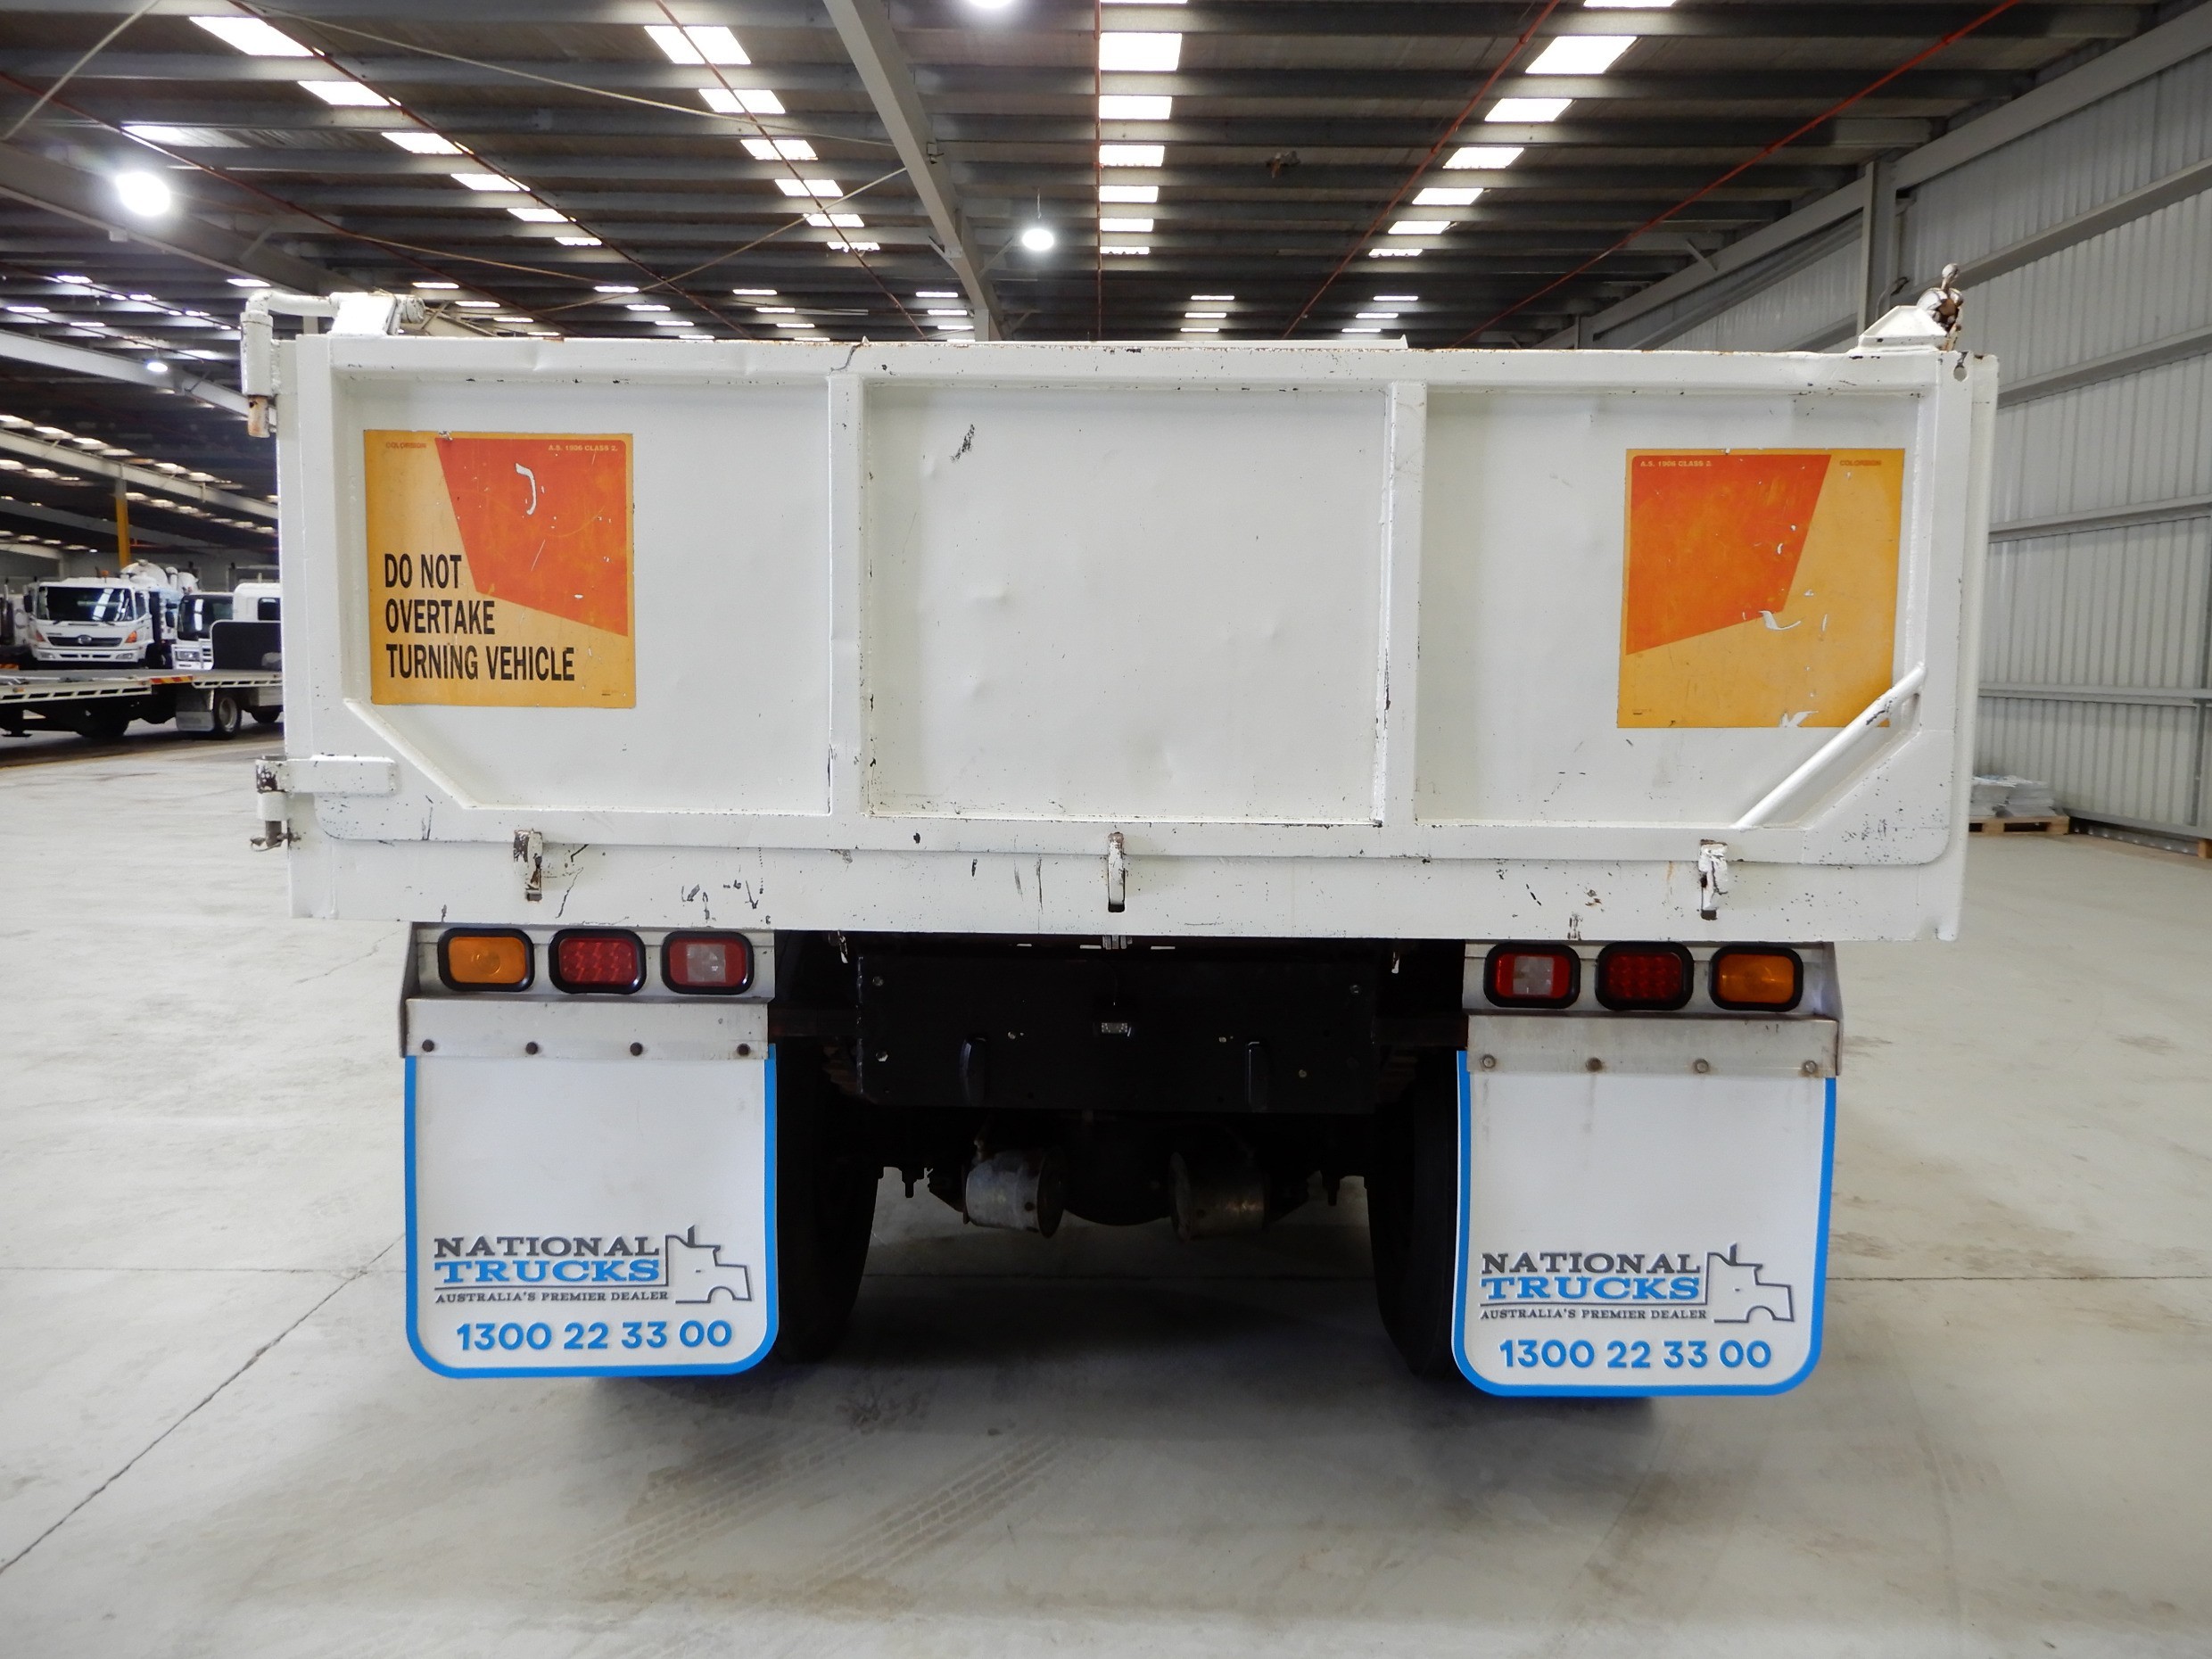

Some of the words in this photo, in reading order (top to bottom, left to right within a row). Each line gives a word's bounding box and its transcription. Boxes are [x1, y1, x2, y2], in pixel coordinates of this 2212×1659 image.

[384, 553, 413, 588] DO
[421, 554, 462, 589] NOT
[385, 599, 495, 635] OVERTAKE
[386, 644, 478, 680] TURNING
[486, 647, 574, 681] VEHICLE
[433, 1236, 660, 1258] NATIONAL
[433, 1259, 660, 1283] TRUCKS
[1482, 1252, 1701, 1274] NATIONAL
[435, 1292, 536, 1304] AUSTRALIA'S
[541, 1292, 606, 1301] PREMIER
[610, 1292, 668, 1300] DEALER
[1480, 1276, 1700, 1300] TRUCKS
[1480, 1308, 1576, 1320] AUSTRALIA'S
[1581, 1310, 1647, 1319] PREMIER
[1651, 1310, 1707, 1319] DEALER
[457, 1322, 552, 1350] 1300
[563, 1322, 609, 1349] 22
[622, 1321, 668, 1349] 33
[679, 1320, 732, 1348] 00
[1499, 1340, 1595, 1367] 1300
[1606, 1340, 1651, 1367] 22
[1663, 1340, 1708, 1367] 33
[1720, 1340, 1771, 1368] 00
